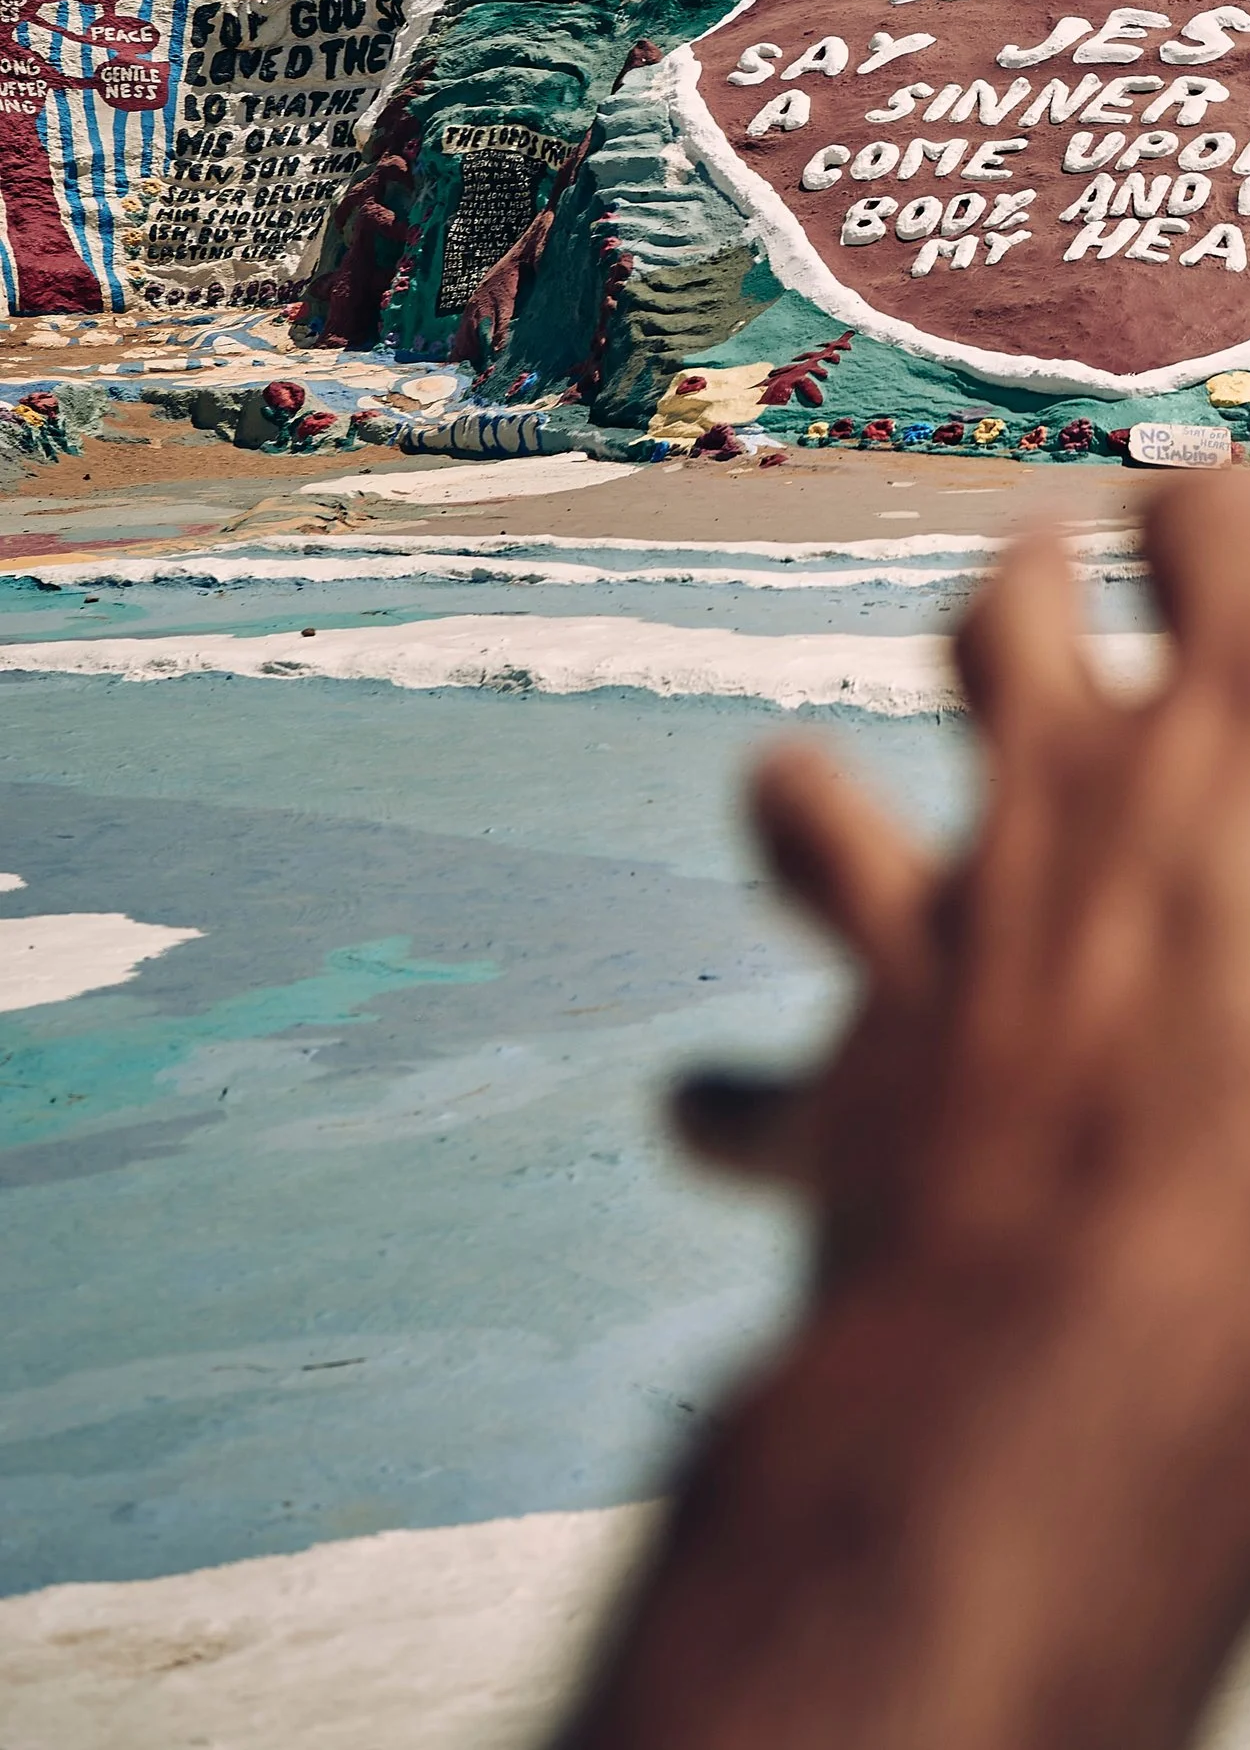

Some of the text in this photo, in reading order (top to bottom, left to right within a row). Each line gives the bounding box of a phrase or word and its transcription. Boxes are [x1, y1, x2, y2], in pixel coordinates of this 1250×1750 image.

[90, 26, 154, 43] PEACE
[184, 45, 314, 87] LOVED
[726, 31, 938, 87] SAY
[100, 65, 162, 84] GENTLE
[105, 83, 158, 100] NESS
[746, 88, 812, 137] A
[864, 72, 1231, 128] SINNER
[245, 119, 329, 153] ONLY
[446, 126, 486, 148] THE
[172, 159, 235, 185] TEN
[242, 155, 301, 181] SON
[802, 137, 1030, 191] COME
[156, 206, 201, 223] HIM
[203, 207, 294, 229] SHOULD
[840, 188, 1037, 245] BODY
[1059, 172, 1212, 223] AND
[198, 226, 247, 245] BUT
[252, 225, 308, 245] HAVE
[911, 229, 1034, 278] MY
[1140, 429, 1171, 445] NO
